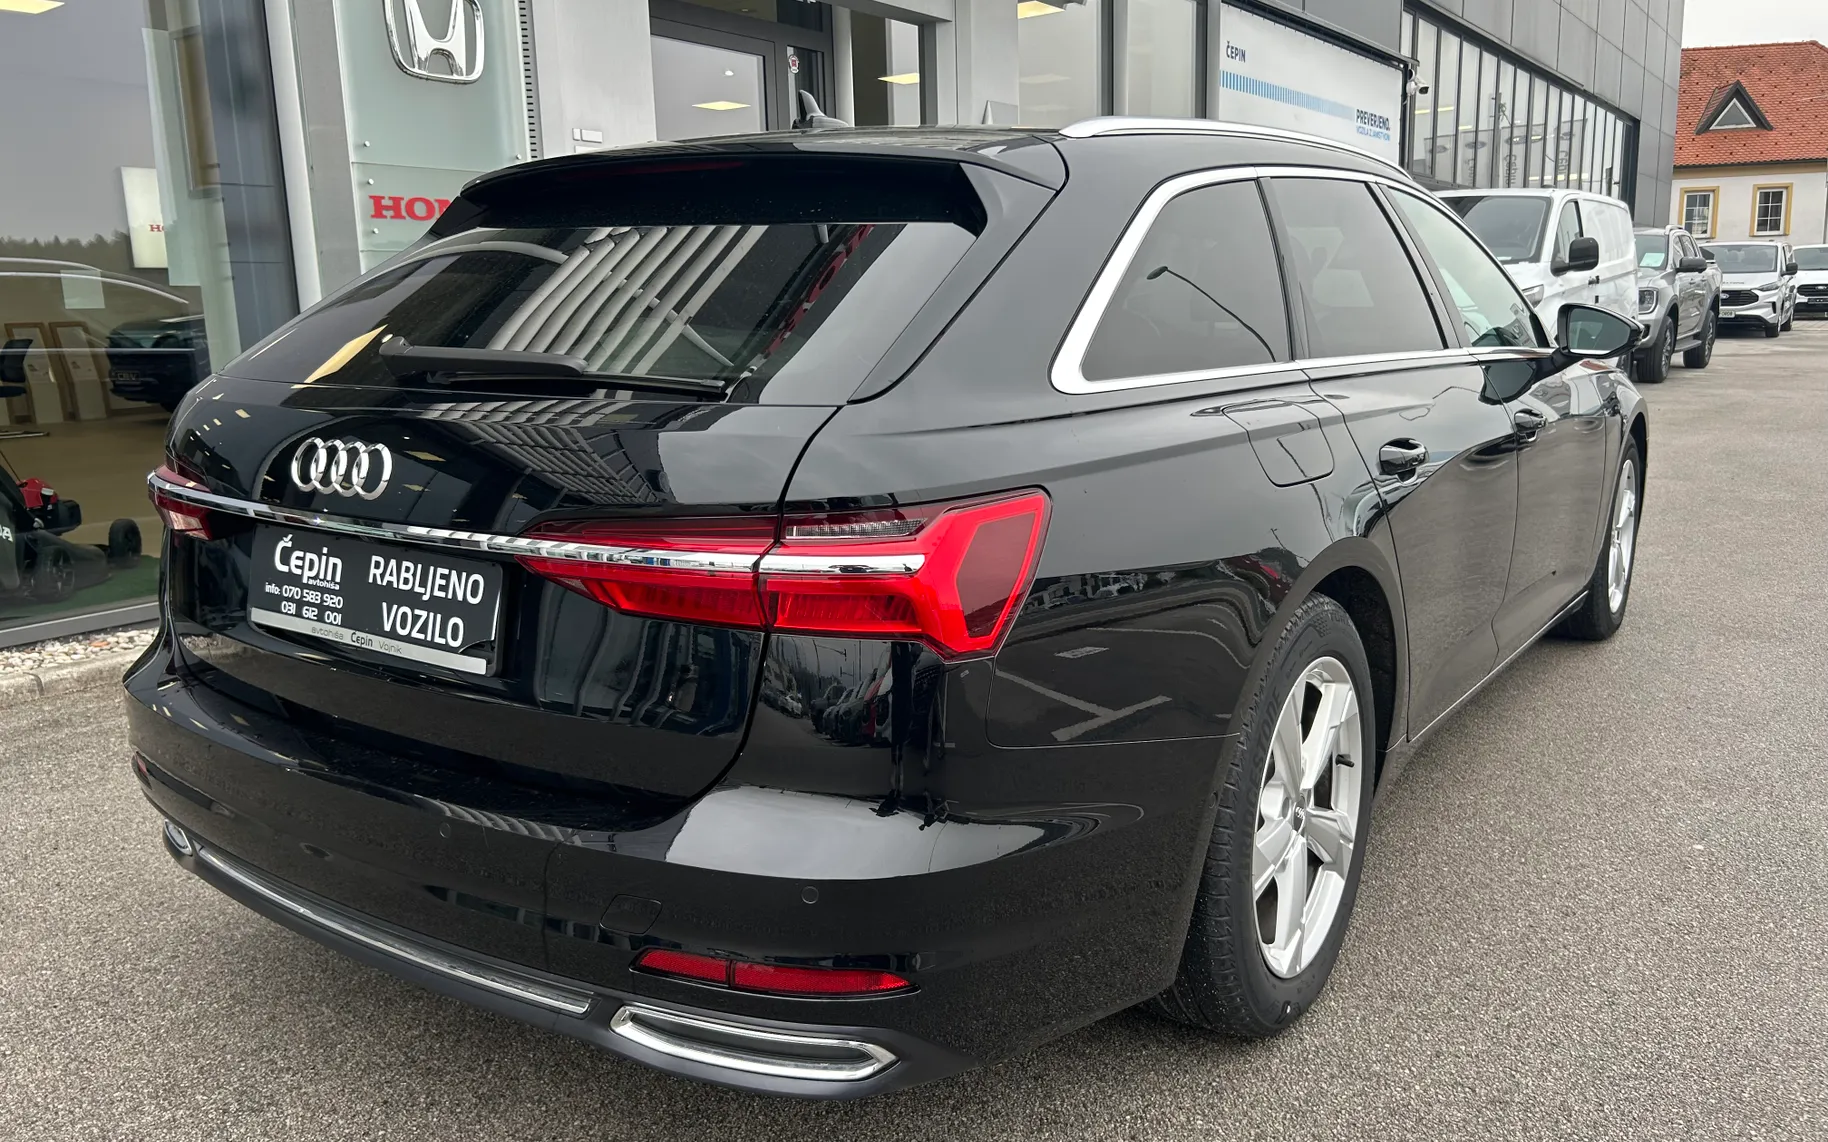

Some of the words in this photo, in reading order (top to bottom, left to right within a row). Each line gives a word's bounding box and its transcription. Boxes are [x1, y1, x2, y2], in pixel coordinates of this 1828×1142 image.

[1225, 40, 1246, 63] ČEPIN
[274, 533, 343, 584] Čepin
[307, 578, 340, 590] avtohiša
[368, 555, 485, 605] RABLJENO
[265, 582, 281, 595] info:
[282, 585, 301, 599] 070
[302, 589, 321, 604] 583
[323, 594, 344, 609] 920
[281, 601, 296, 615] 031
[302, 606, 318, 620] 612
[324, 611, 342, 625] 001
[382, 601, 464, 648] VOZILO
[350, 630, 373, 647] Čepin
[378, 641, 402, 654] Vojnik
